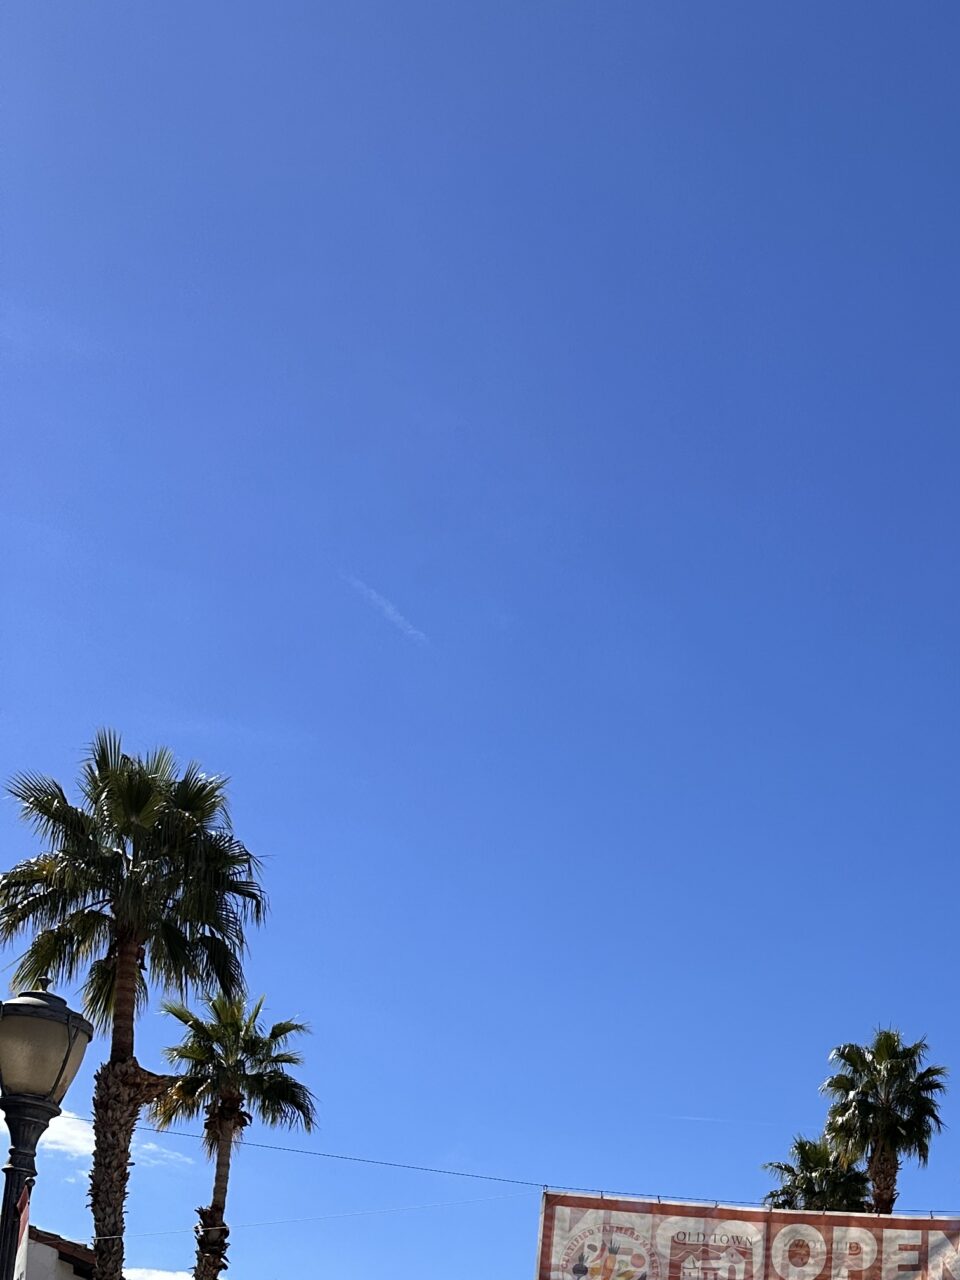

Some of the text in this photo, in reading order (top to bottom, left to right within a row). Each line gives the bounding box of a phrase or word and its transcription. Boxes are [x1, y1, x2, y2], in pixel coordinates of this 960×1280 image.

[561, 1225, 659, 1277] CERTIFIED FARMERS MARKET
[676, 1231, 753, 1246] OLD TOWN
